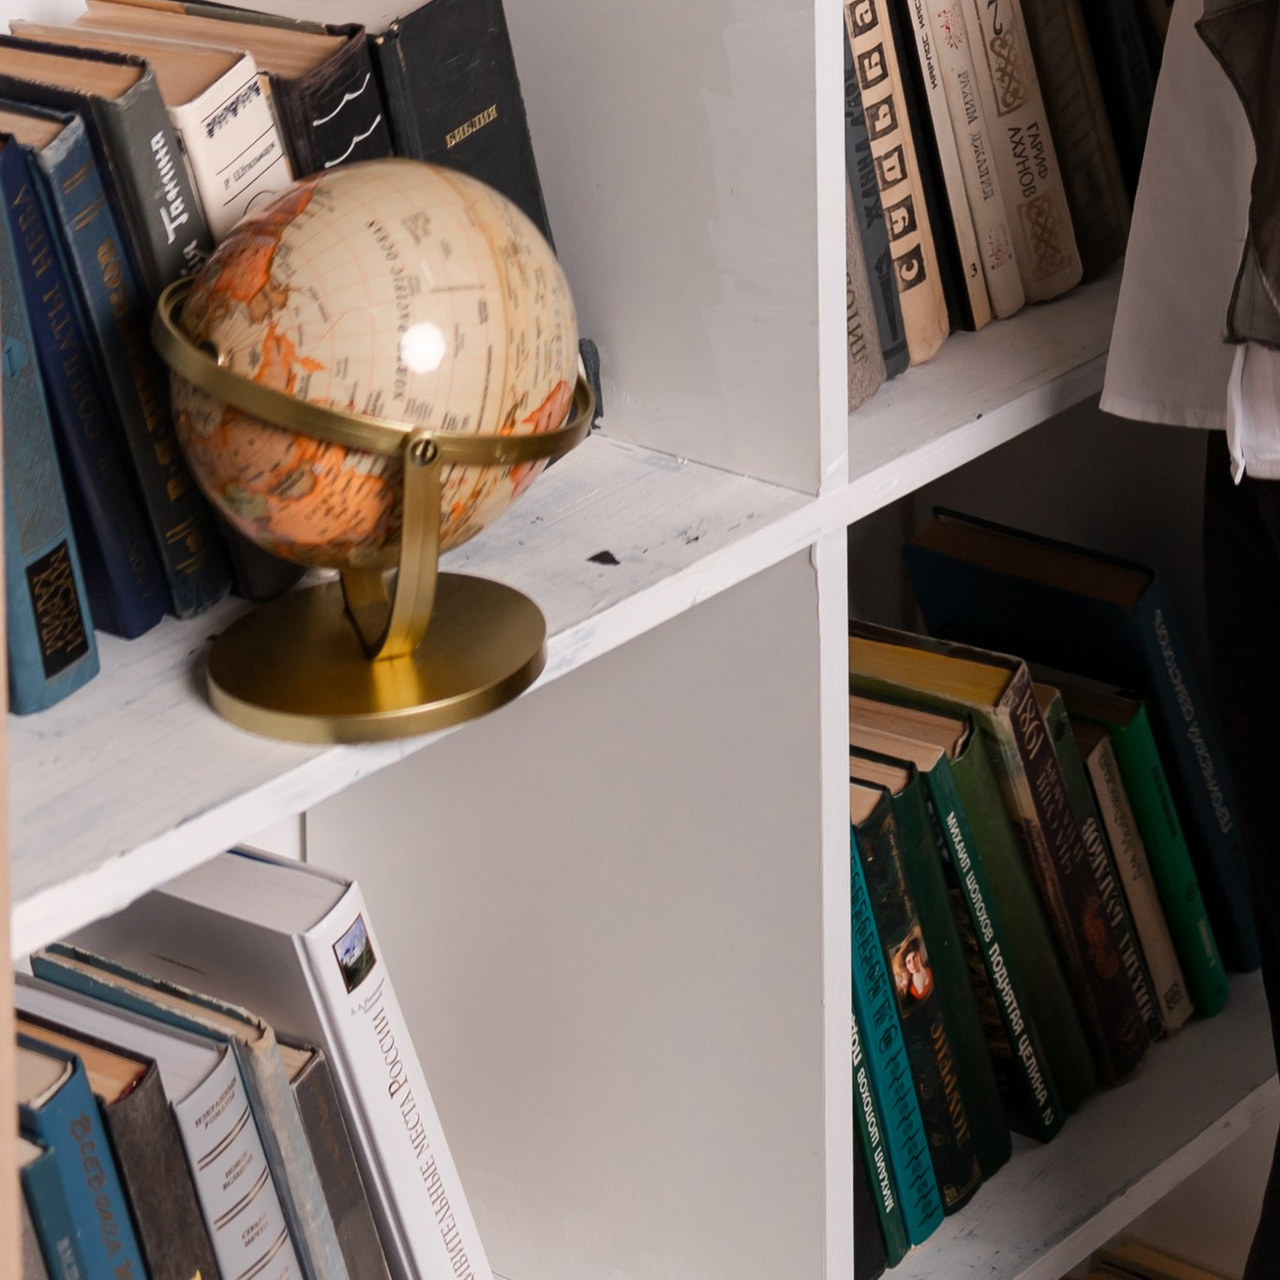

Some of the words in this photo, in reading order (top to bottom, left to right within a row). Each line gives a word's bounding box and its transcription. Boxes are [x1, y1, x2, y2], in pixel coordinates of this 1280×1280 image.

[445, 104, 498, 150] БИБЛИЯ
[1007, 126, 1037, 199] АХУНОВ
[1026, 121, 1050, 182] ГАРИФ
[33, 569, 64, 666] КАРИМ
[48, 547, 87, 652] МУСТАЙ
[1080, 815, 1123, 931] БУЛГАКОВ
[945, 809, 970, 872] МИХАИЛ
[964, 865, 994, 944] ШОЛОХОВ
[988, 942, 1024, 1038] ПОДНЯТАЯ
[1014, 1030, 1048, 1111] ЦЕЛИНА
[1042, 1111, 1053, 1127] 2
[394, 1097, 428, 1160] МЕСТА
[855, 1068, 881, 1146] ШОЛОХОВ
[871, 1148, 896, 1214] МИХАИЛ
